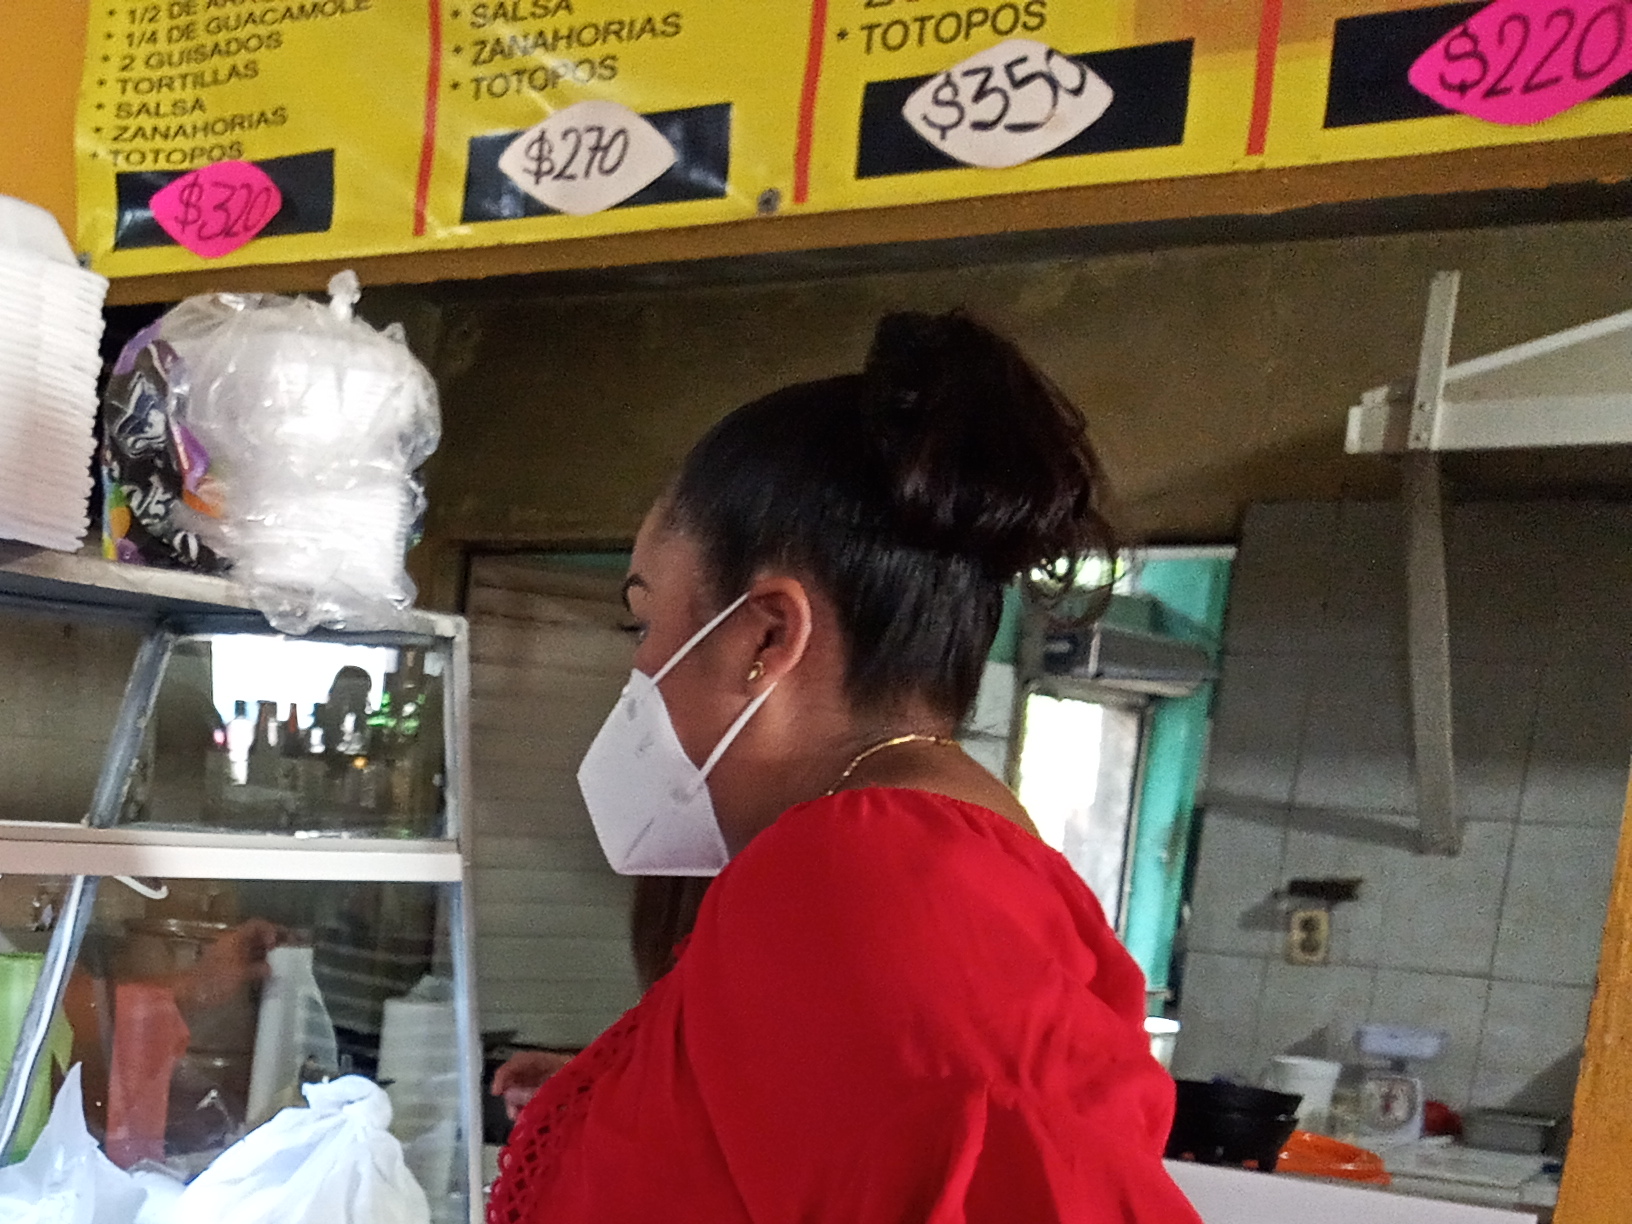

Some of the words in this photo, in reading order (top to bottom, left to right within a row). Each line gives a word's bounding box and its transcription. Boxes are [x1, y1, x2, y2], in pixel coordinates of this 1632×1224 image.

[125, 29, 158, 48] 1/4
[167, 22, 197, 44] DE
[205, 0, 373, 35] GUACAMOLE
[128, 5, 161, 26] 1/2
[168, 1, 198, 20] DE
[469, 0, 574, 29] SALSA
[861, 0, 1047, 56] TOTOPOS
[120, 54, 136, 73] 2
[144, 30, 284, 70] GUISADOS
[471, 11, 683, 66] ZANAHORIAS
[1438, 3, 1627, 98] $220
[116, 59, 259, 96] TORTILLAS
[471, 54, 619, 101] TOTOPOS
[922, 48, 1088, 140] $350
[111, 106, 289, 142] ZANAHORIAS
[115, 97, 207, 120] SALSA
[110, 140, 244, 167] TOTOPOS
[523, 126, 629, 185] $270
[174, 173, 272, 242] $320
